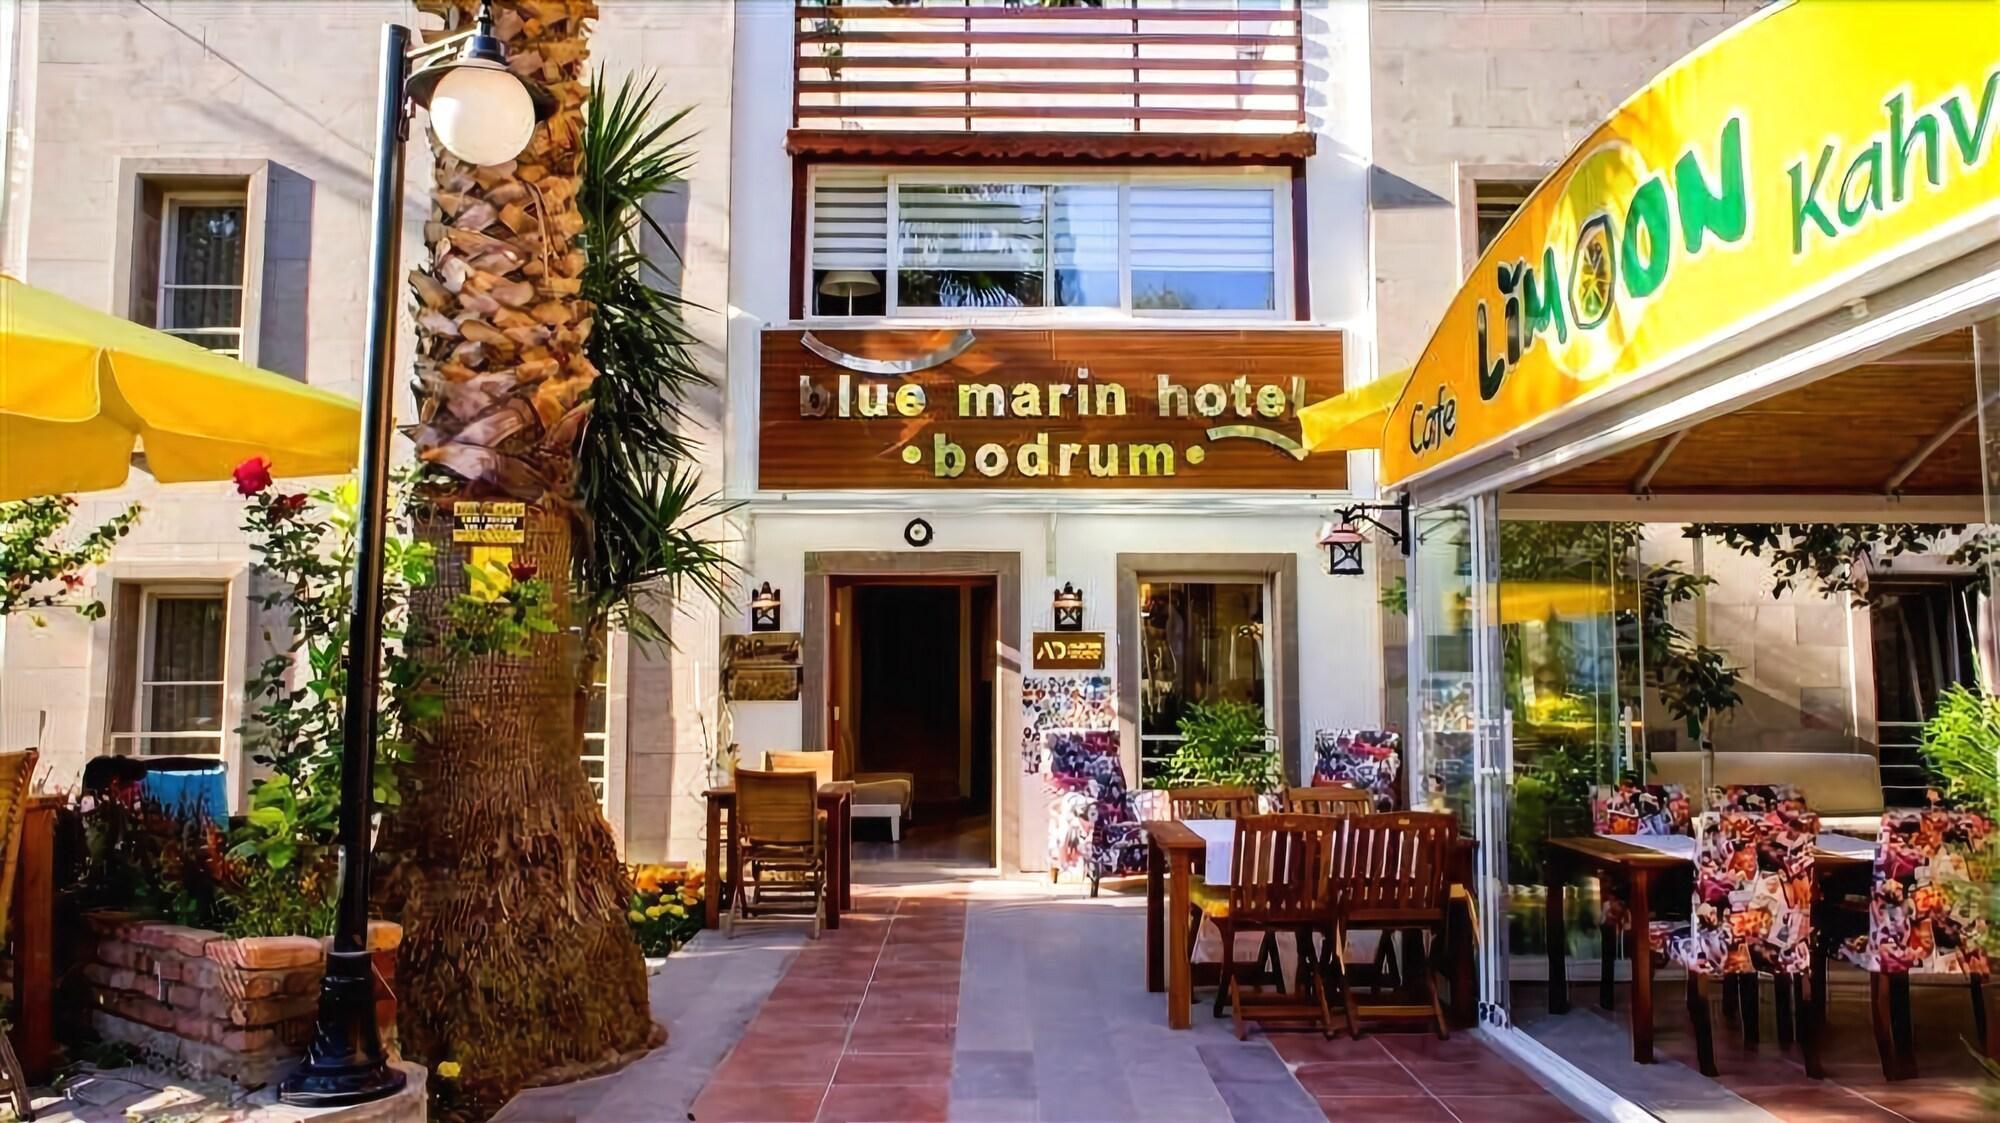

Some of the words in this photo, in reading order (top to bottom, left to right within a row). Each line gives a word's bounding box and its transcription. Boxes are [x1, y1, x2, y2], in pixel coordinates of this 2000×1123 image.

[799, 374, 926, 418] blue
[958, 368, 1126, 417] marin
[1157, 374, 1306, 418] hotel
[1410, 385, 1456, 455] Cafe
[933, 432, 1176, 478] bodrum
